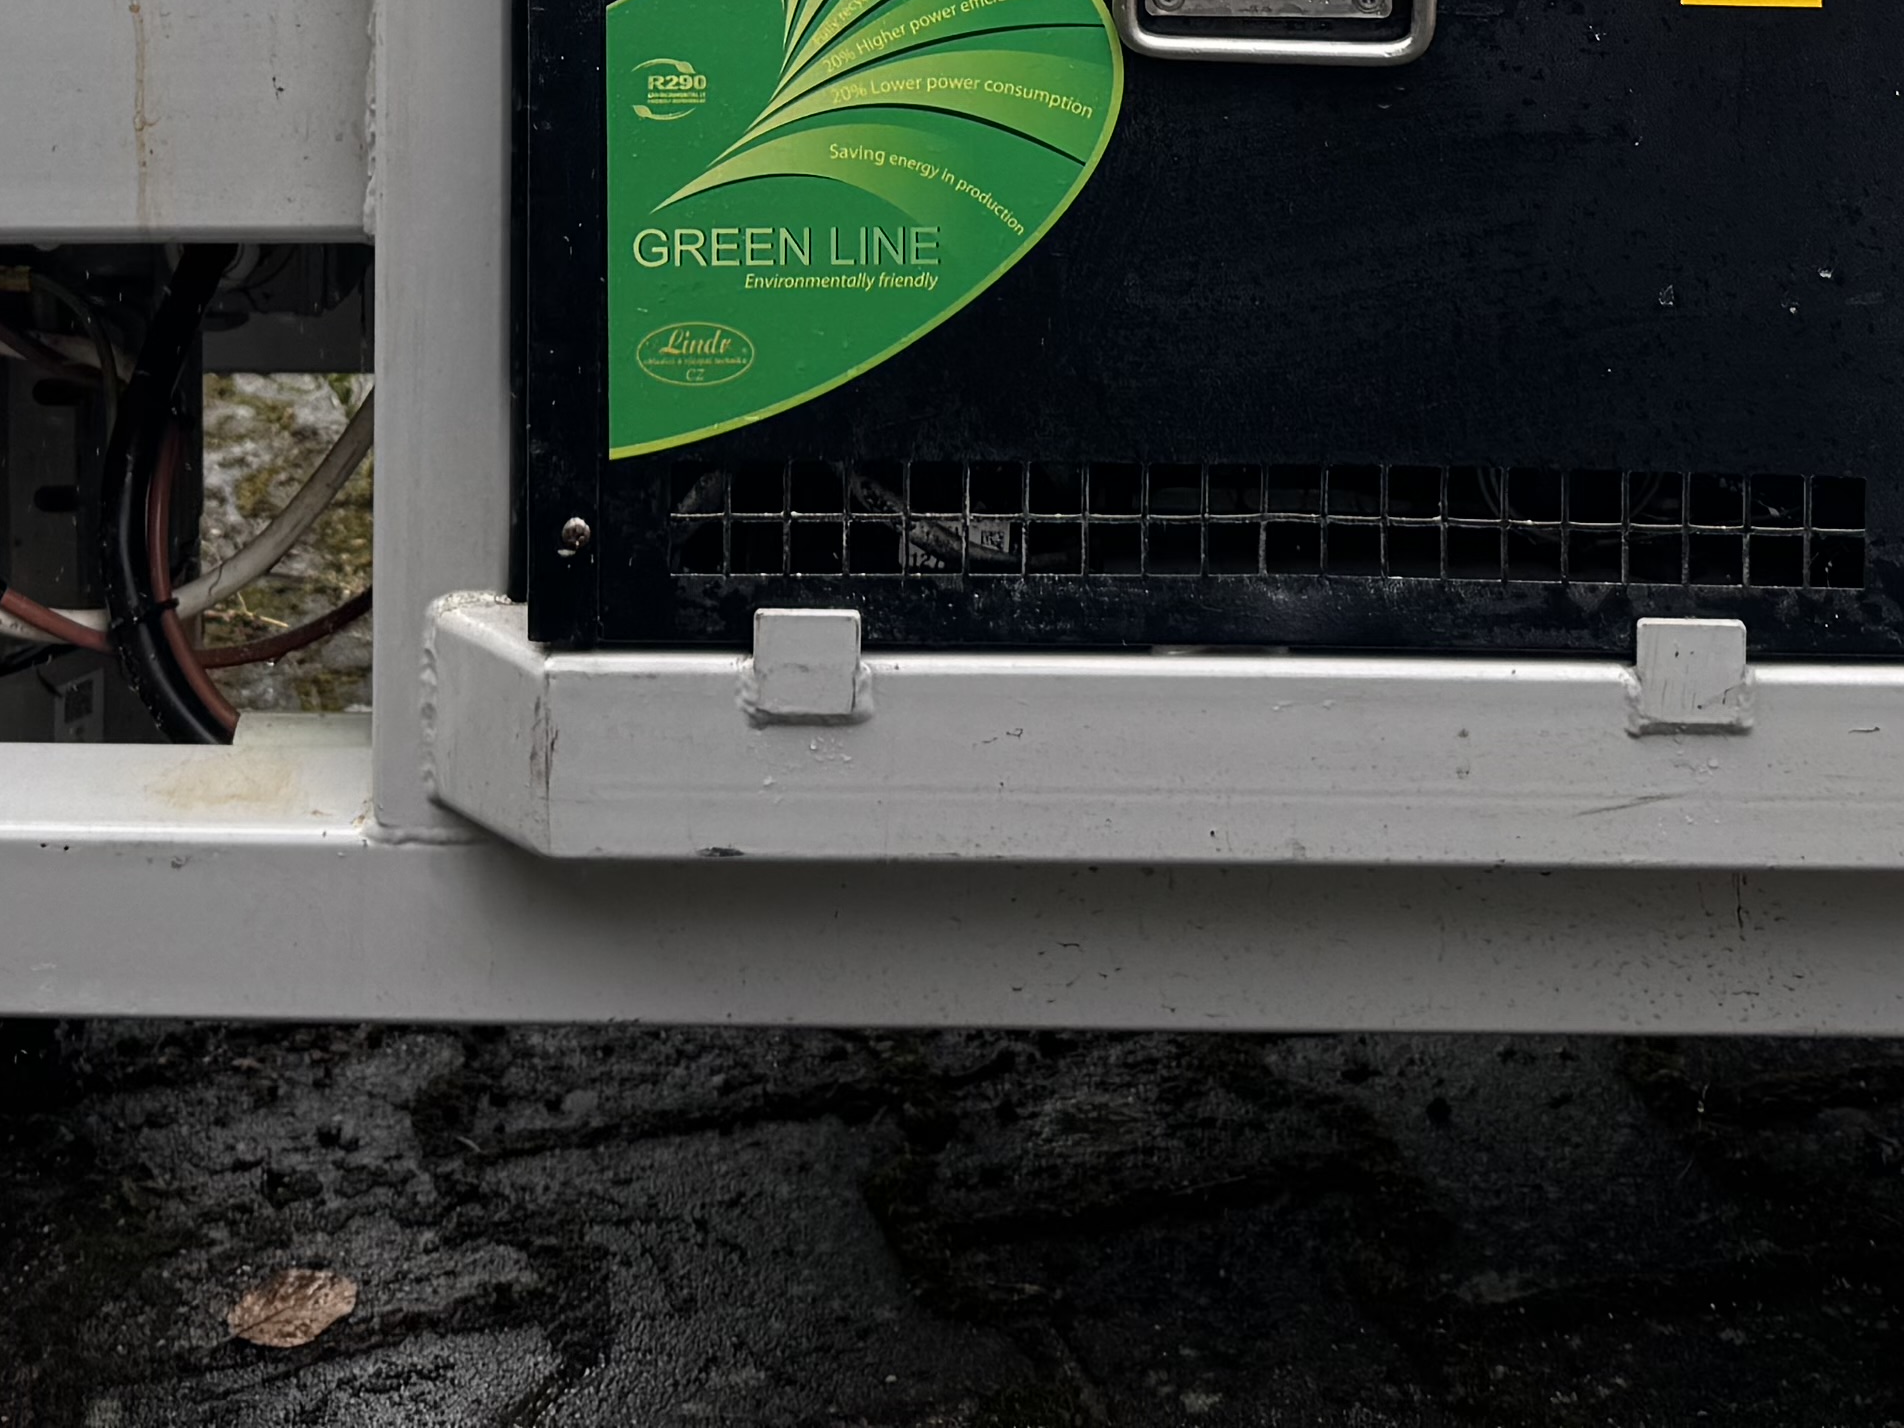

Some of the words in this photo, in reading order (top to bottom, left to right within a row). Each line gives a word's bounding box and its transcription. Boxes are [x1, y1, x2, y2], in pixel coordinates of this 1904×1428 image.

[823, 49, 857, 74] 20%
[855, 24, 908, 55] Higher
[909, 4, 958, 36] power
[647, 74, 707, 90] R290
[831, 84, 868, 105] 20%
[870, 76, 922, 94] Lower
[926, 75, 981, 96] power
[984, 78, 1094, 119] consumption
[829, 143, 886, 166] Saving
[889, 153, 940, 180] energy
[941, 166, 957, 186] in
[955, 178, 1026, 237] production
[632, 227, 813, 268] GREEN
[829, 225, 942, 266] LINE
[744, 273, 876, 291] Environmentally
[878, 272, 940, 291] friendly
[658, 328, 732, 356] Lindr
[685, 368, 705, 382] CZ
